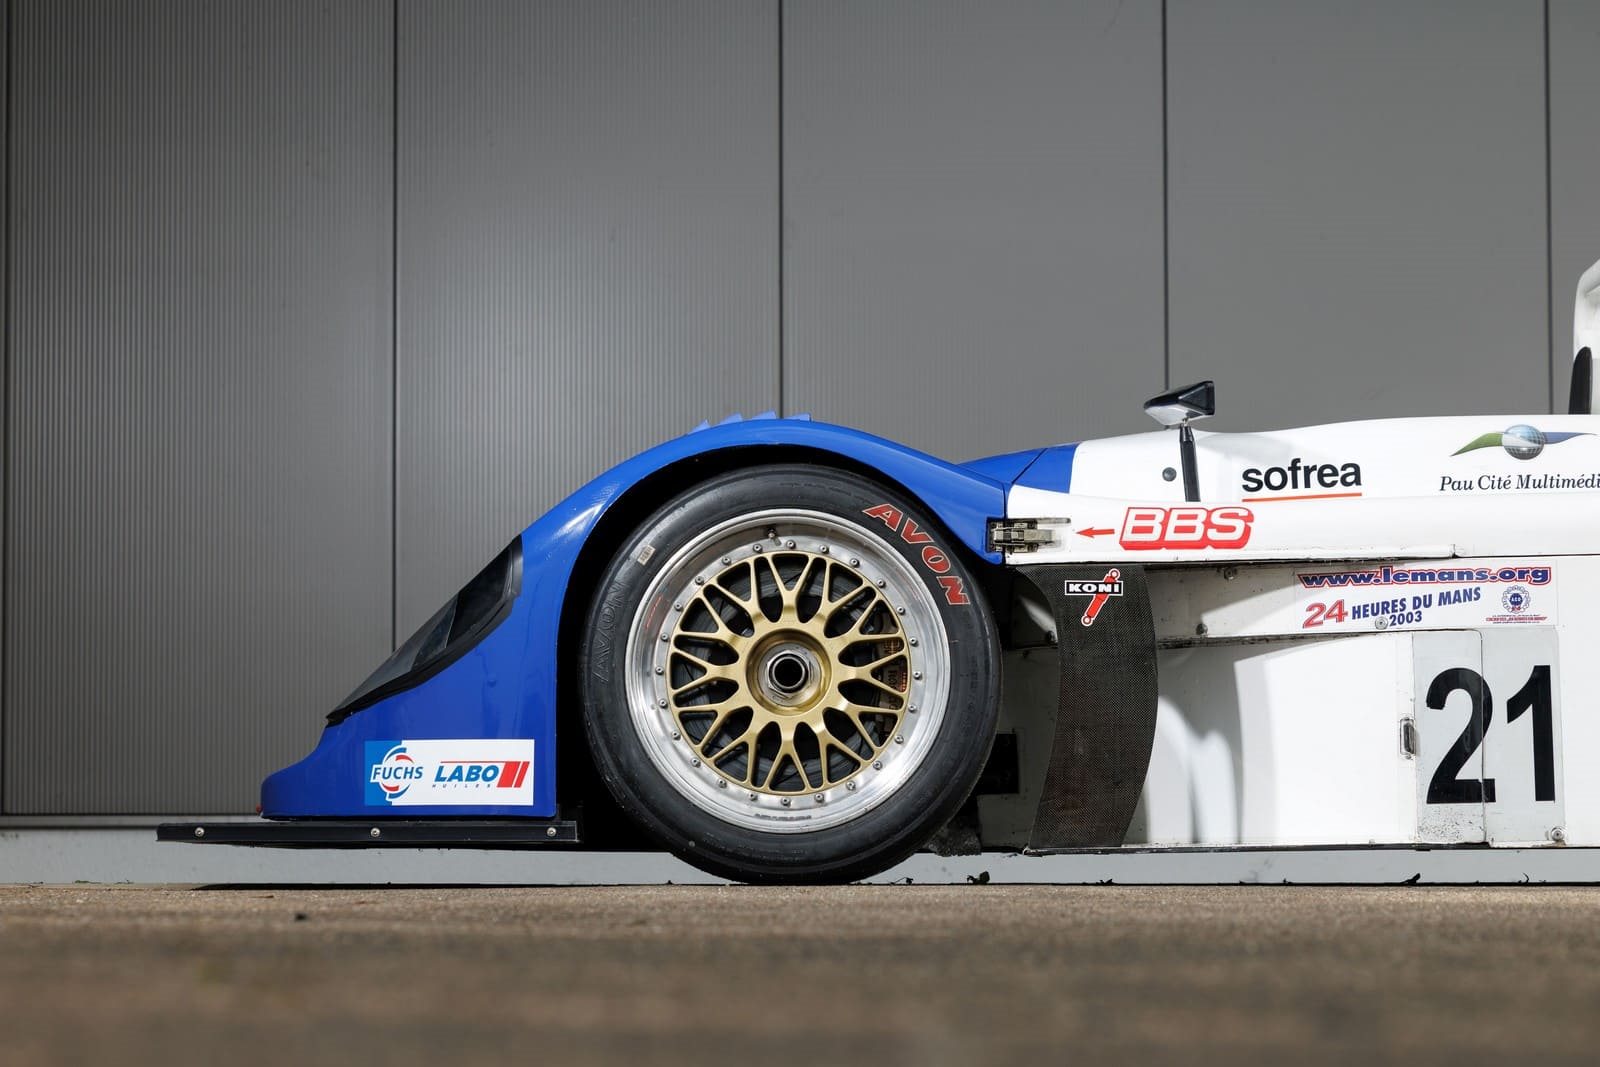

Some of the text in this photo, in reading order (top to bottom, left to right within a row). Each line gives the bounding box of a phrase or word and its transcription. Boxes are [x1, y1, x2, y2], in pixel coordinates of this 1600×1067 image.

[1242, 457, 1362, 492] sofrea
[1440, 476, 1474, 491] Pau
[1478, 474, 1512, 490] Cité
[1119, 506, 1255, 550] BBS
[862, 503, 971, 605] AVON
[1067, 582, 1120, 593] KONI
[1298, 566, 1551, 588] www.lemans.org
[1302, 586, 1482, 628] 24 HEURES DU MANS
[1388, 610, 1423, 627] 2003
[1426, 664, 1556, 805] 21
[372, 766, 423, 780] FUCHS
[434, 764, 500, 782] LABO
